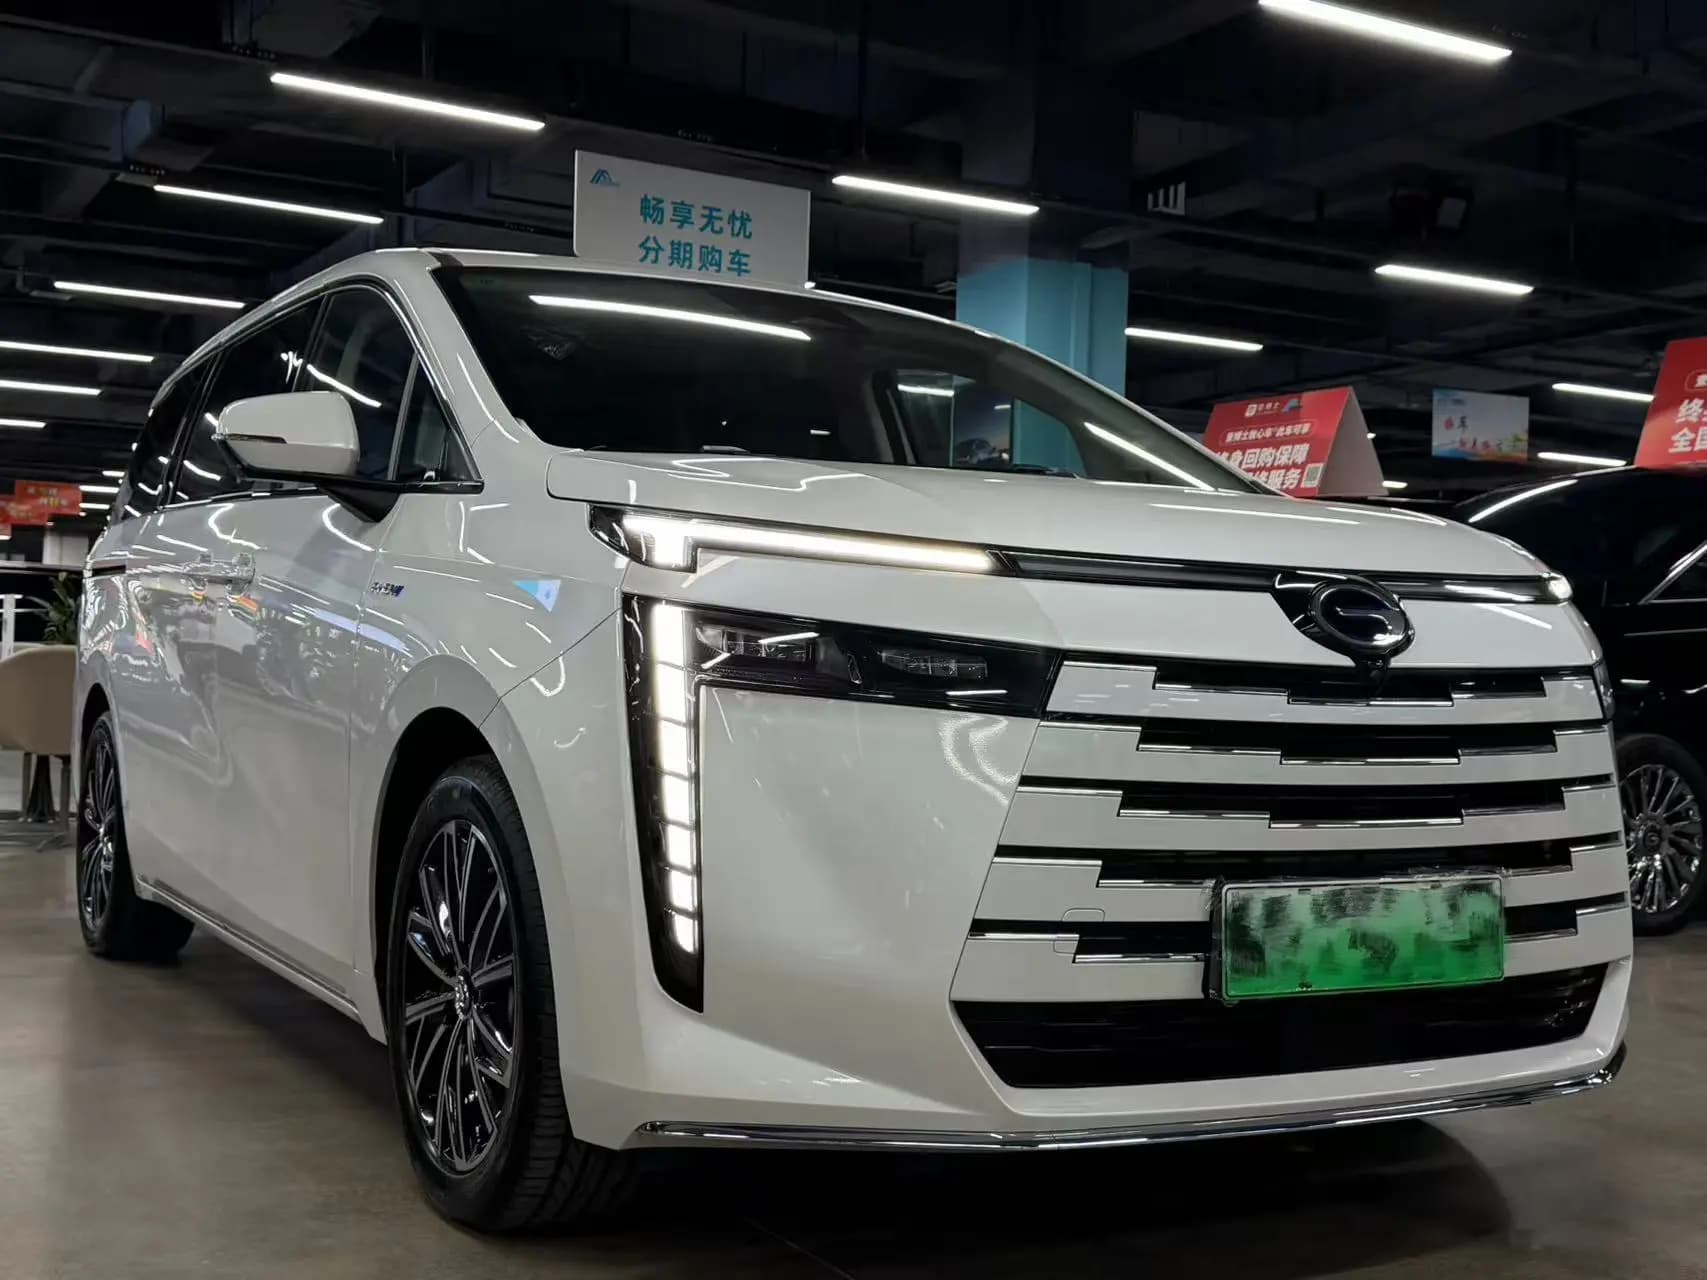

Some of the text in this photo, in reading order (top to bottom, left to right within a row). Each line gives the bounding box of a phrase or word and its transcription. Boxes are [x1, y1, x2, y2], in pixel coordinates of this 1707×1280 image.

[640, 194, 752, 239] 畅享无忧
[639, 236, 751, 276] 分期购车
[1675, 398, 1707, 424] 终
